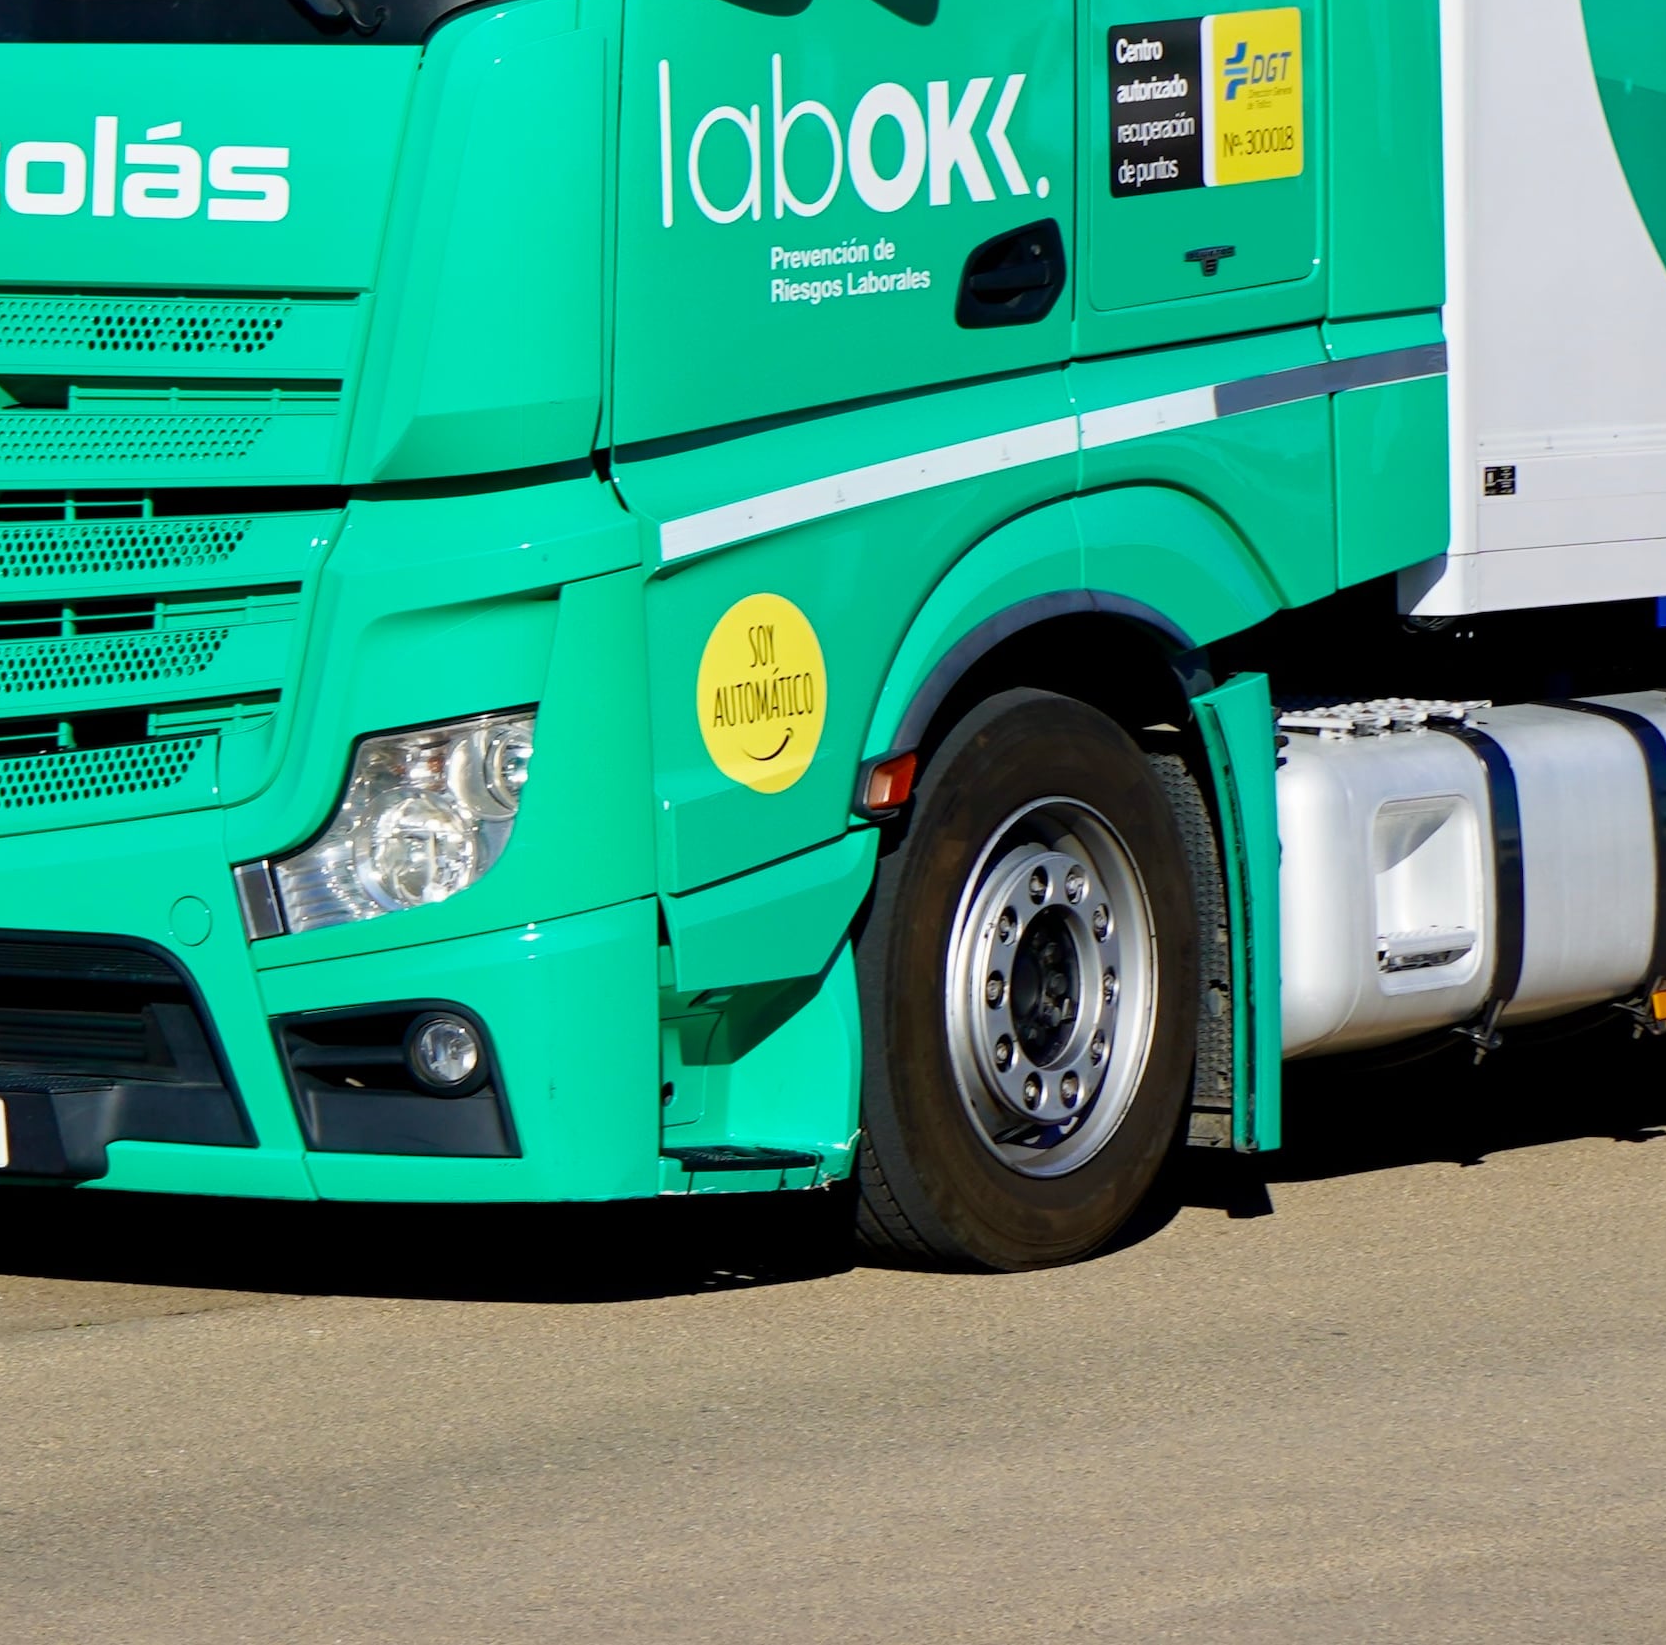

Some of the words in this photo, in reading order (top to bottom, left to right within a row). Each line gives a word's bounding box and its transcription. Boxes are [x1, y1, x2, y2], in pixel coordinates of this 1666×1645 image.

[1116, 38, 1164, 64] Centro
[1251, 51, 1293, 84] DGT
[1116, 73, 1189, 104] autorizado
[1117, 111, 1196, 147] recuperación
[1118, 159, 1135, 184] de
[1136, 156, 1179, 188] puntos
[770, 237, 869, 270] Prevención
[873, 237, 896, 261] de
[771, 278, 843, 305] Riesgos
[847, 267, 931, 296] Laborales
[748, 624, 775, 668] SOY
[713, 667, 815, 728] AUTOMÁTICO
